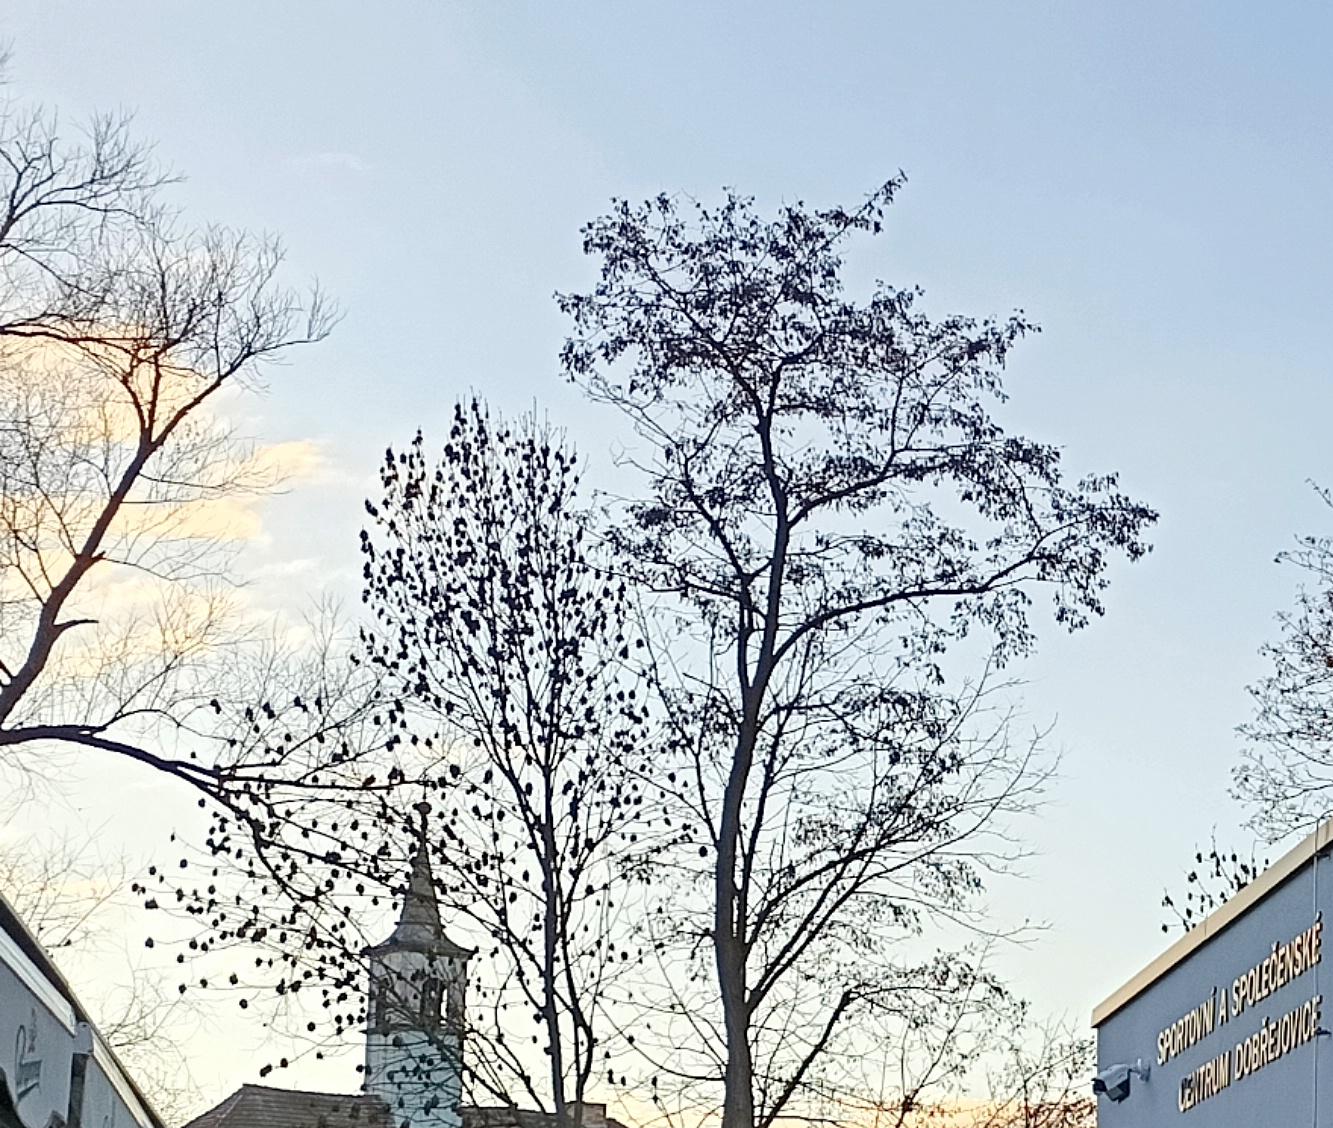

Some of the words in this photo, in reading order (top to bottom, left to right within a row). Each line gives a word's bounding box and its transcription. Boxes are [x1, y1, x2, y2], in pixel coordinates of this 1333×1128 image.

[1157, 986, 1218, 1065] SPORTOVNÍ
[1218, 988, 1229, 1026] A
[1231, 911, 1323, 1017] SPOLEČENSKÉ
[1178, 1050, 1232, 1113] CENTRUM
[1234, 995, 1323, 1081] DOBŘEJOVICE
